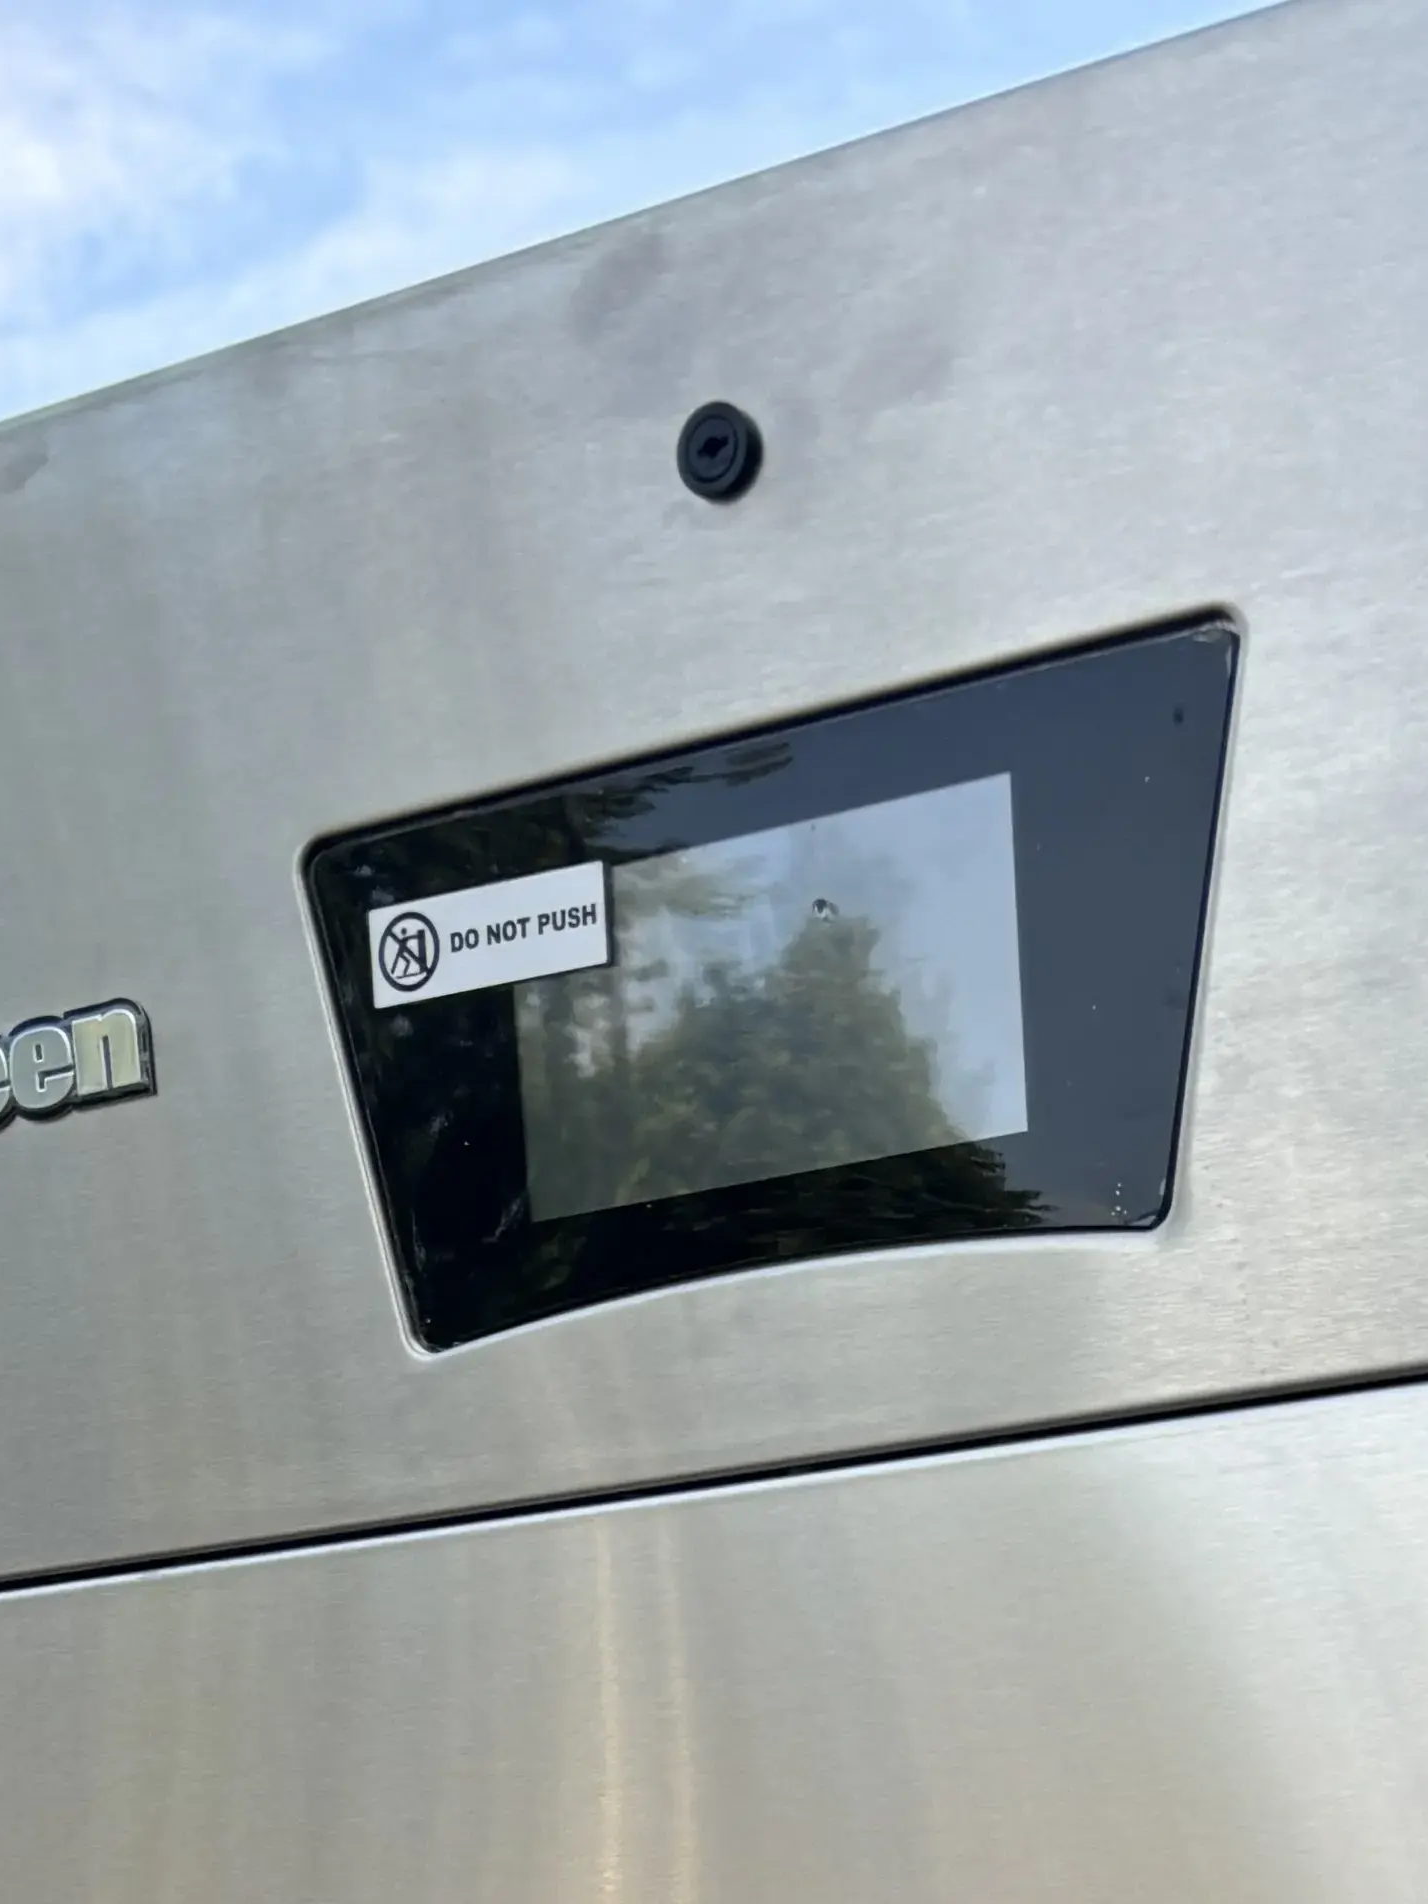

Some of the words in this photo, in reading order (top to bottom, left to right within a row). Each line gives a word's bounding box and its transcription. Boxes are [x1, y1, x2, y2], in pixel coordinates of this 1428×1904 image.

[450, 928, 479, 953] DO
[486, 917, 531, 946] NOT
[537, 903, 597, 936] PUSH
